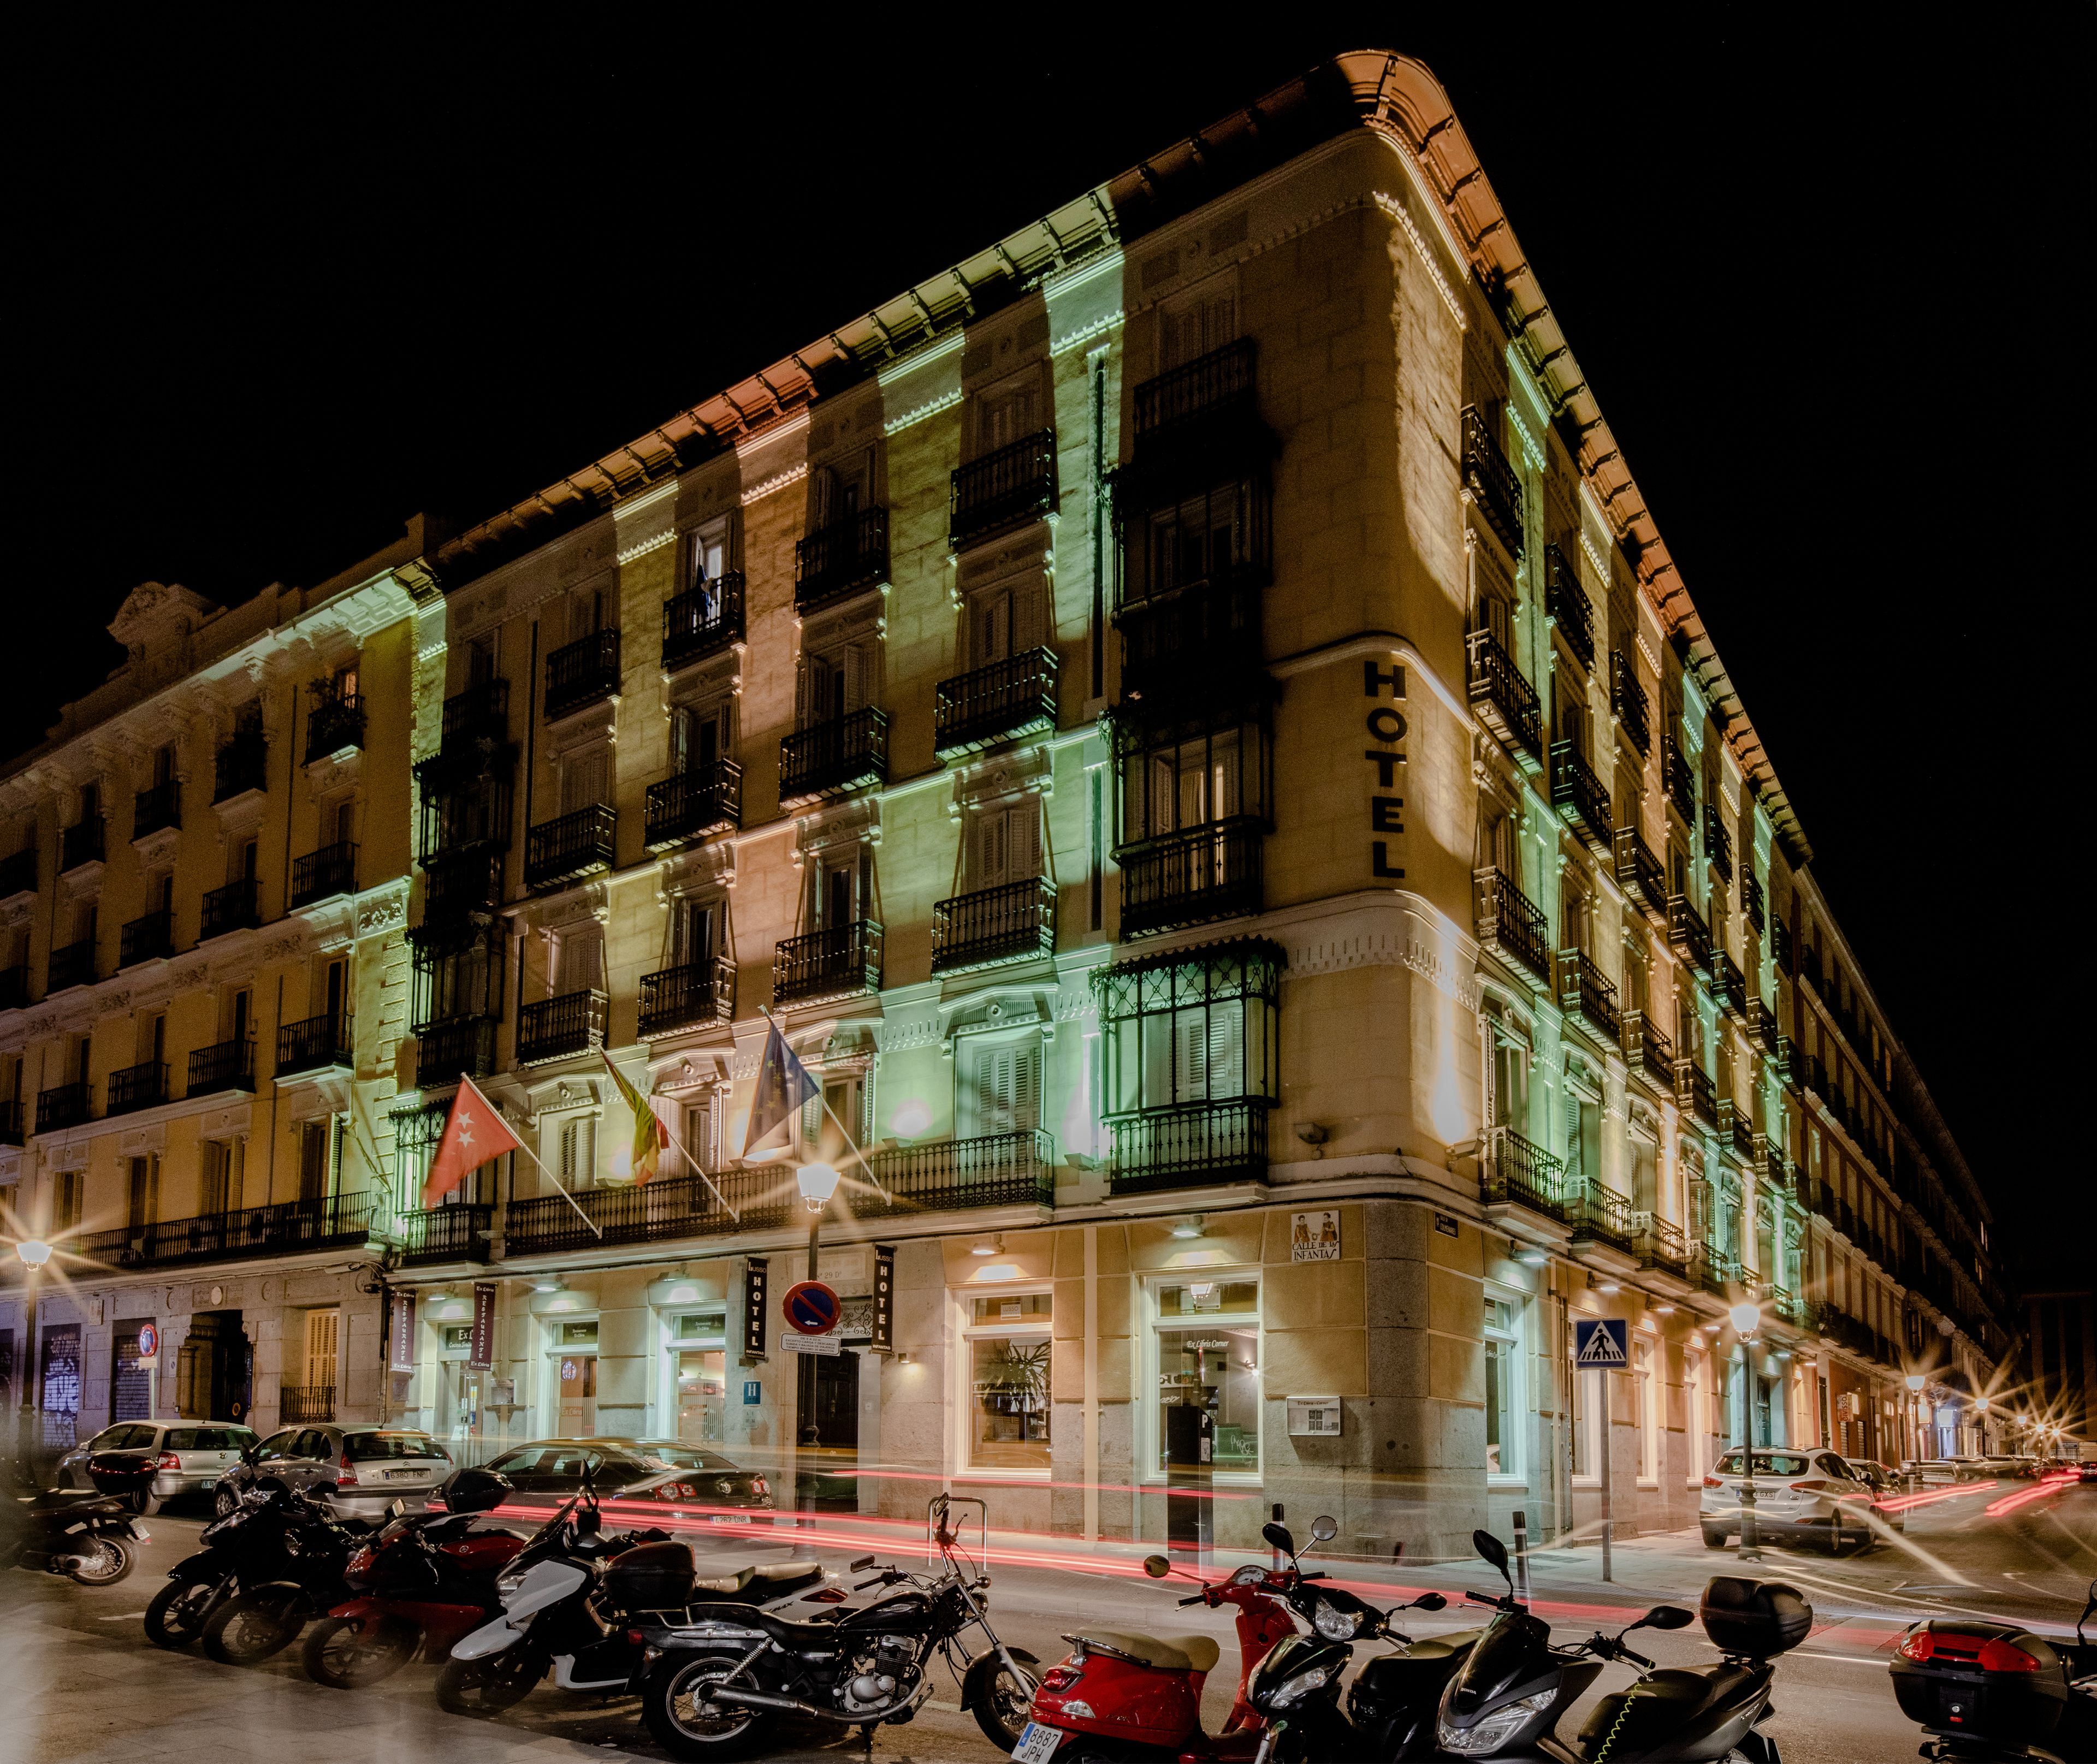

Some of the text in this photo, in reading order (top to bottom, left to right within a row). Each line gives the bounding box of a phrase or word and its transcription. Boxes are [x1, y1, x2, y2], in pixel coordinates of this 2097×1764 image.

[1365, 660, 1408, 879] HOTEL
[1292, 1242, 1317, 1250] CALLE
[875, 1249, 893, 1262] LUSSO
[1294, 1249, 1337, 1260] INFANTAS
[748, 1261, 767, 1274] LUSSO
[878, 1266, 888, 1341] HOTEL
[751, 1276, 762, 1347] HOTEL
[478, 1294, 487, 1359] RESTAURANTE
[458, 1329, 468, 1340] Ex
[1186, 1339, 1229, 1349] Ex Libris Corner
[748, 1383, 756, 1396] H
[1201, 1414, 1209, 1428] P
[1030, 1729, 1058, 1748] 8687
[1021, 1745, 1044, 1763] JPH
